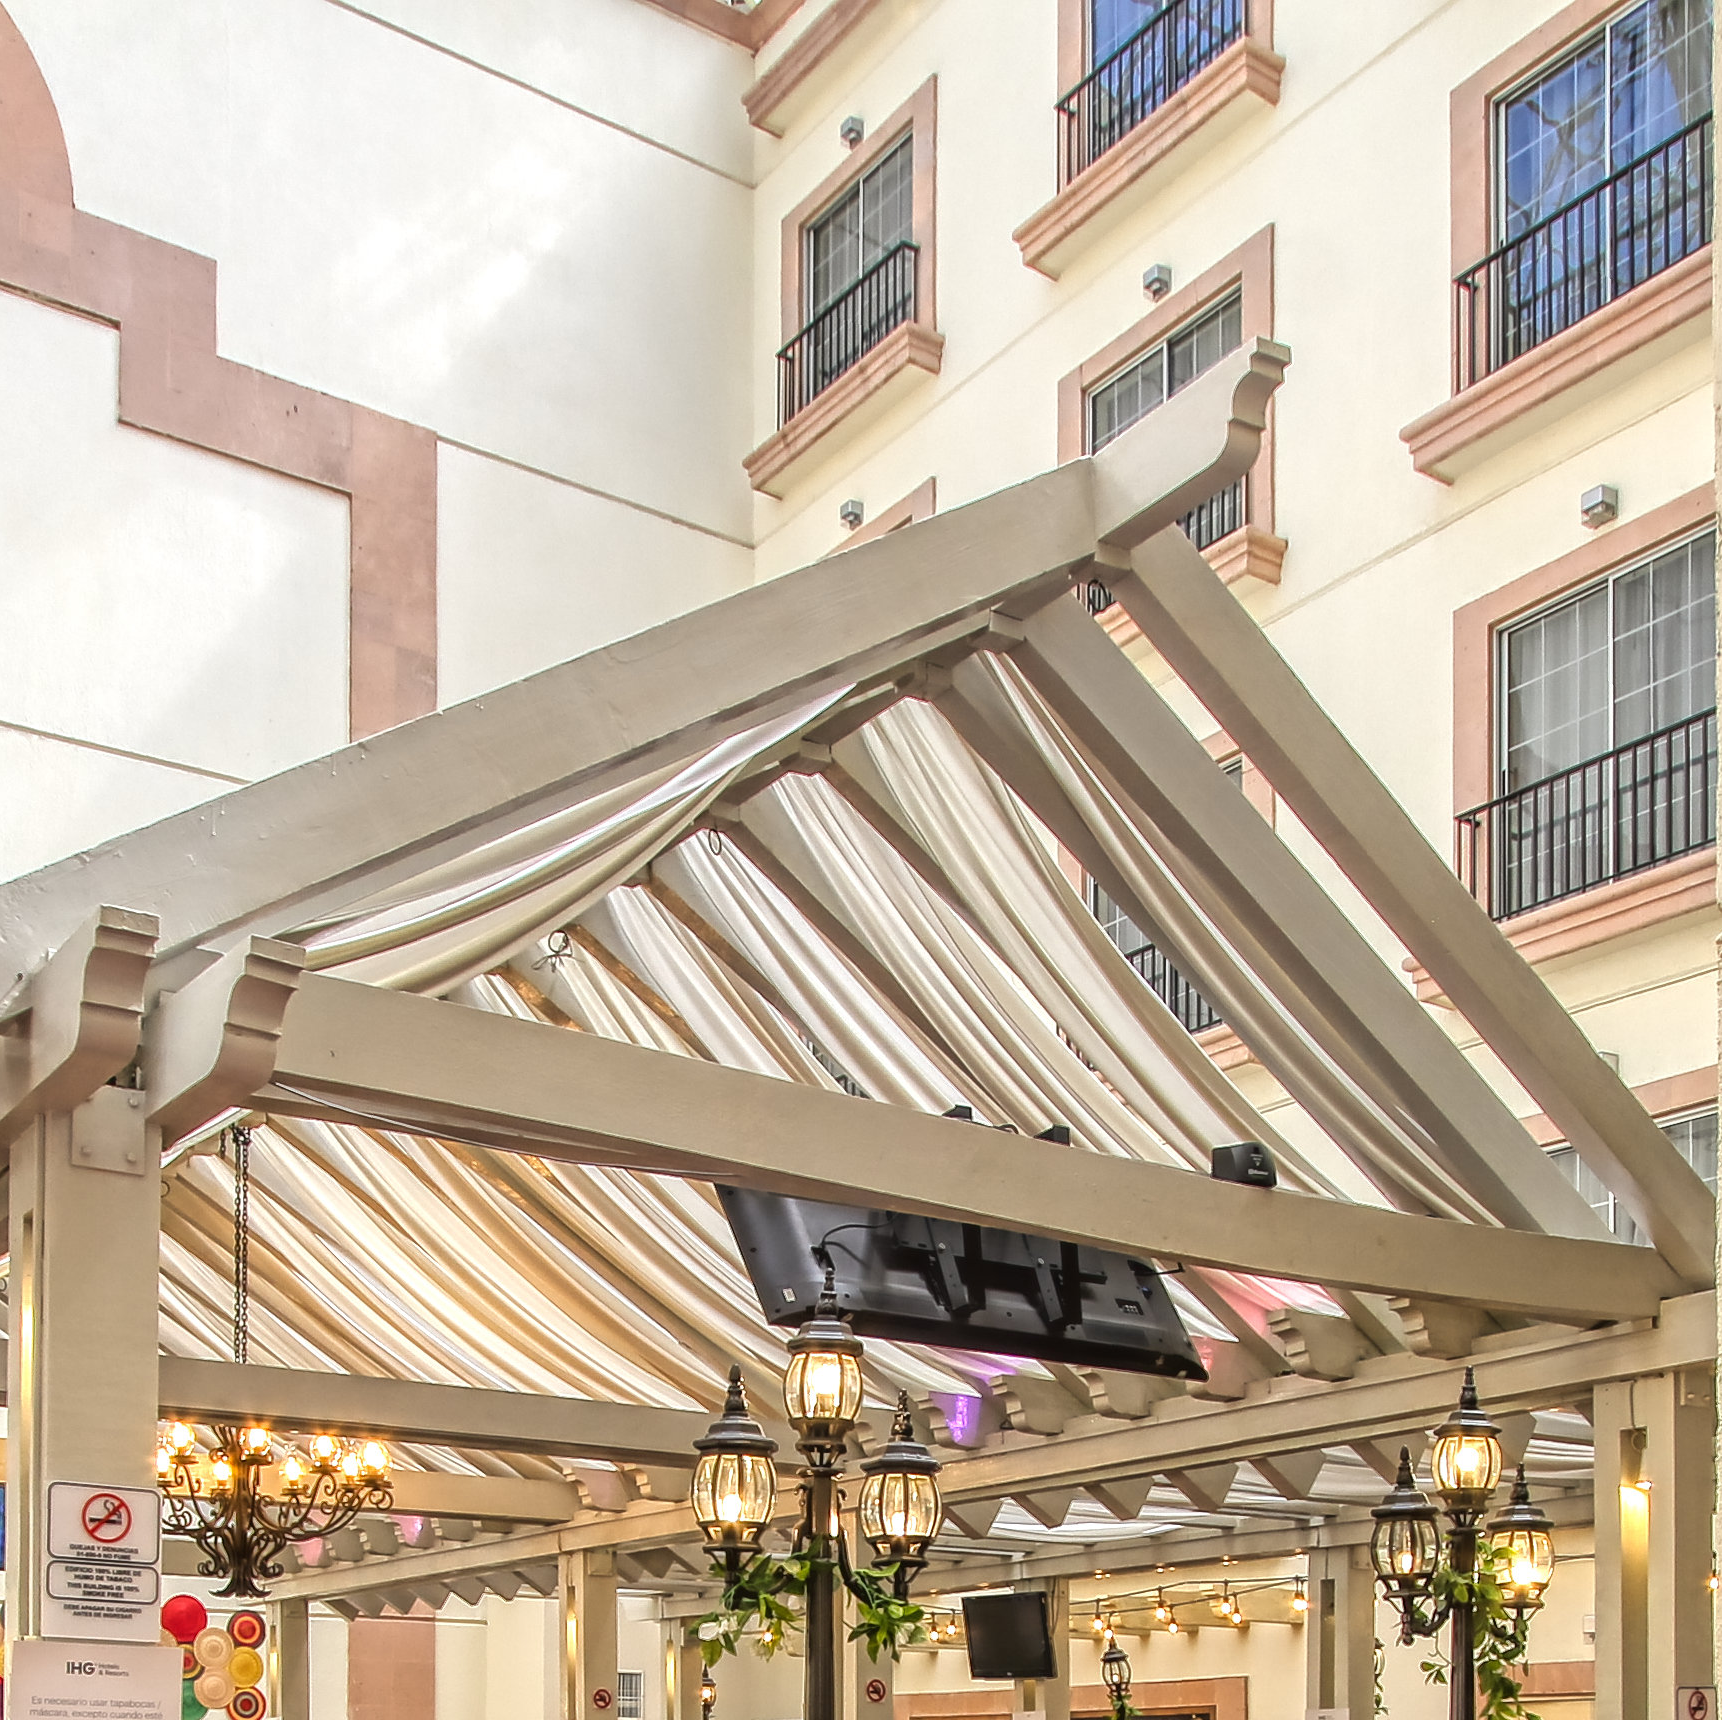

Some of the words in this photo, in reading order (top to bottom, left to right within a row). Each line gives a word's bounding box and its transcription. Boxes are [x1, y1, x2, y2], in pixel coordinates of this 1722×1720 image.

[66, 1662, 95, 1675] IHG
[32, 1696, 42, 1704] Es
[44, 1698, 87, 1706] necesario
[110, 1699, 155, 1709] tapabocas
[72, 1710, 108, 1719] excepto
[110, 1710, 142, 1719] cuando
